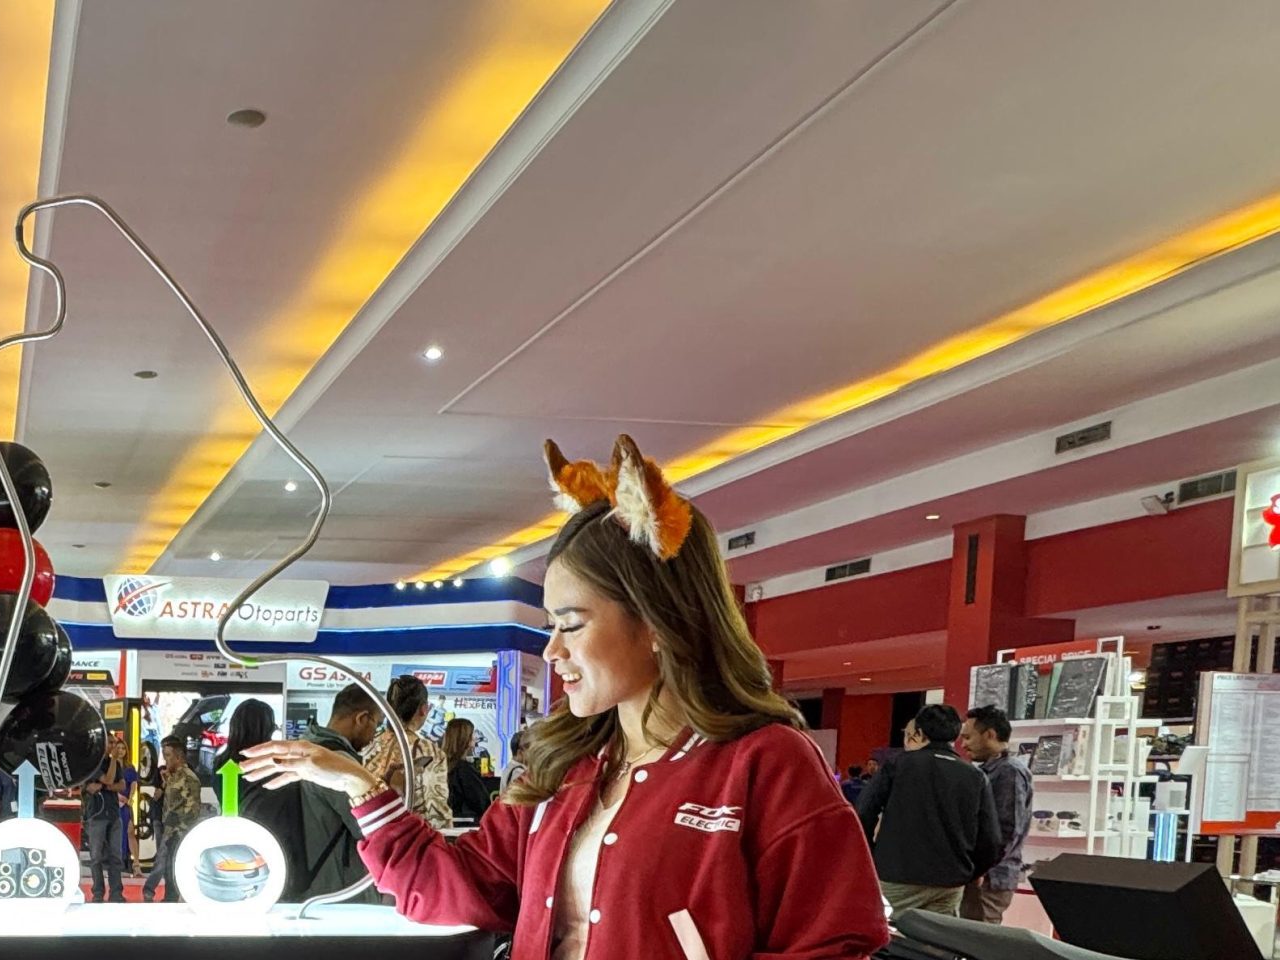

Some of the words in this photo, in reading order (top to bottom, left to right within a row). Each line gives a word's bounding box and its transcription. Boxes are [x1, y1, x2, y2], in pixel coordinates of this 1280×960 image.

[159, 601, 234, 619] ASTRA
[237, 603, 318, 625] Otoparts
[299, 667, 327, 681] GS
[678, 802, 743, 818] FOX
